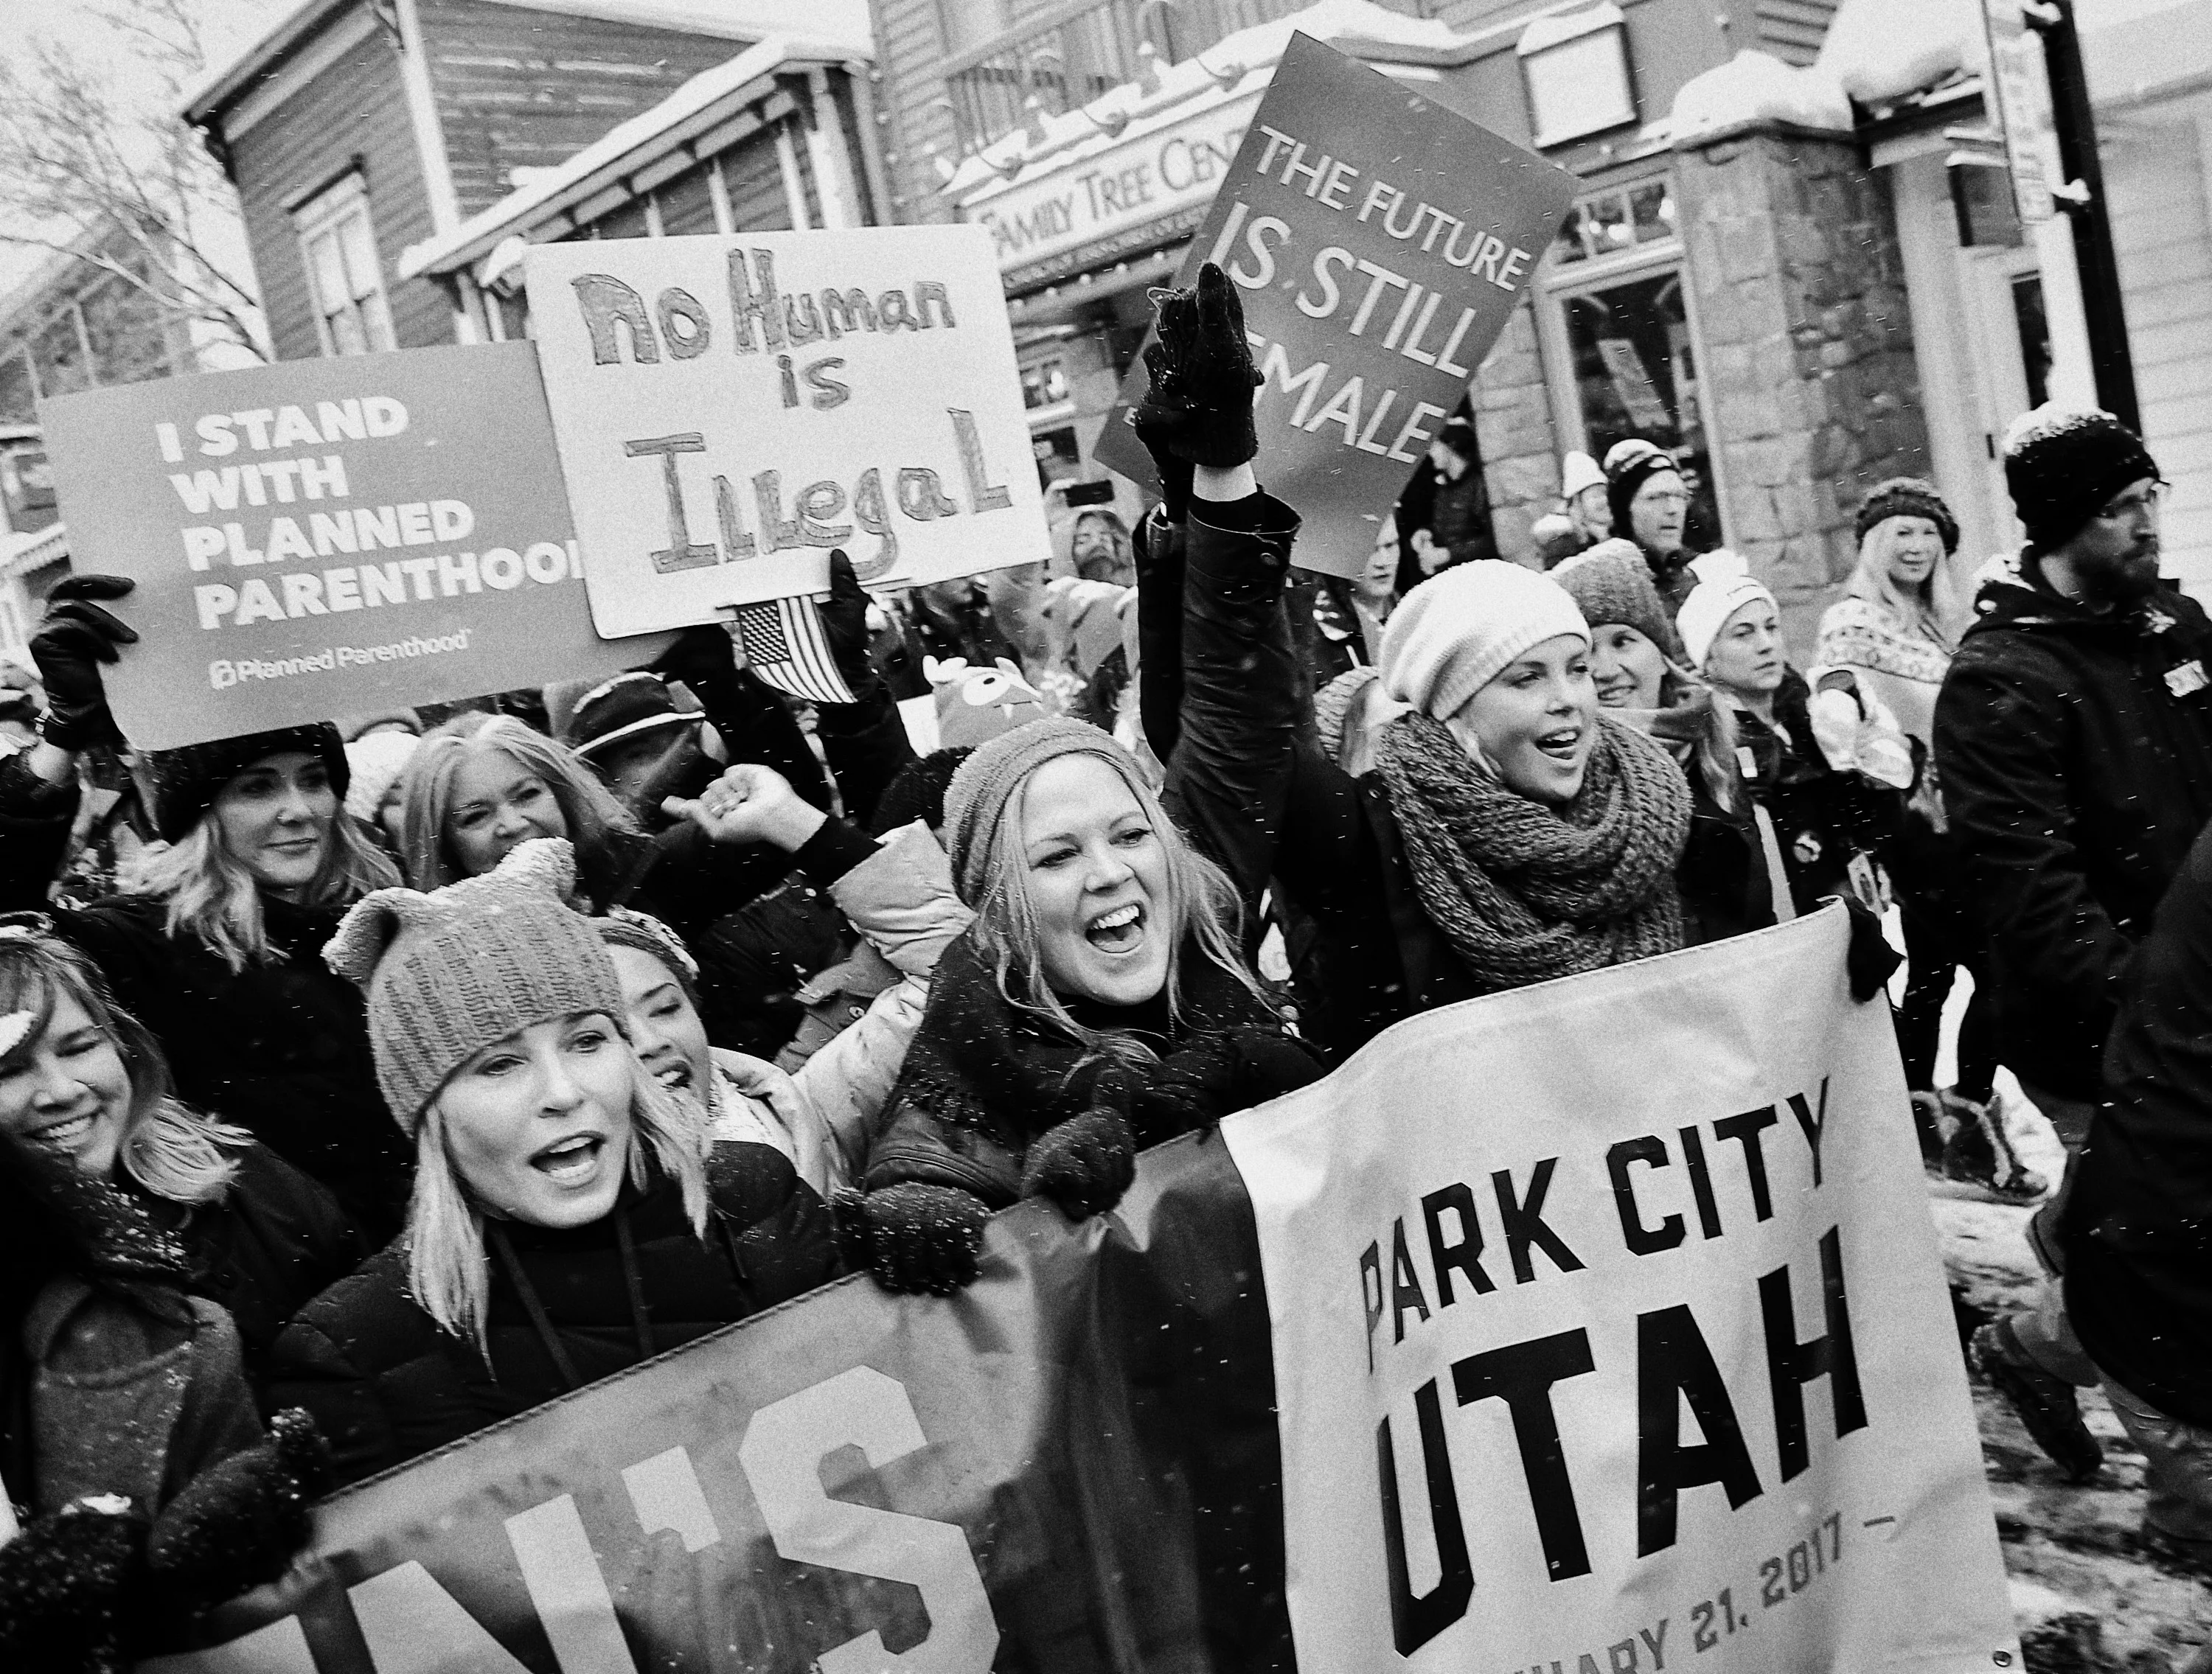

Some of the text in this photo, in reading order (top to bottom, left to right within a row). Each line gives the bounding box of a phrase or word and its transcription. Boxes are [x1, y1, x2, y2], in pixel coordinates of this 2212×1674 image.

[1076, 162, 1155, 221] TREE
[1158, 127, 1249, 191] CEN
[1256, 125, 1532, 292] THE FUTURE
[726, 248, 957, 356] Human
[1208, 200, 1477, 379] IS STILL
[156, 396, 409, 463] I STAND
[776, 354, 850, 411] is
[1246, 329, 1447, 464] MALE
[169, 455, 350, 514] WITH
[180, 499, 476, 571] PLANNED
[234, 632, 469, 682] Planned Parenthood
[1359, 1075, 1830, 1375] PARK CITY
[1376, 1224, 1869, 1659] UTAH
[1759, 1511, 1842, 1608] 2017
